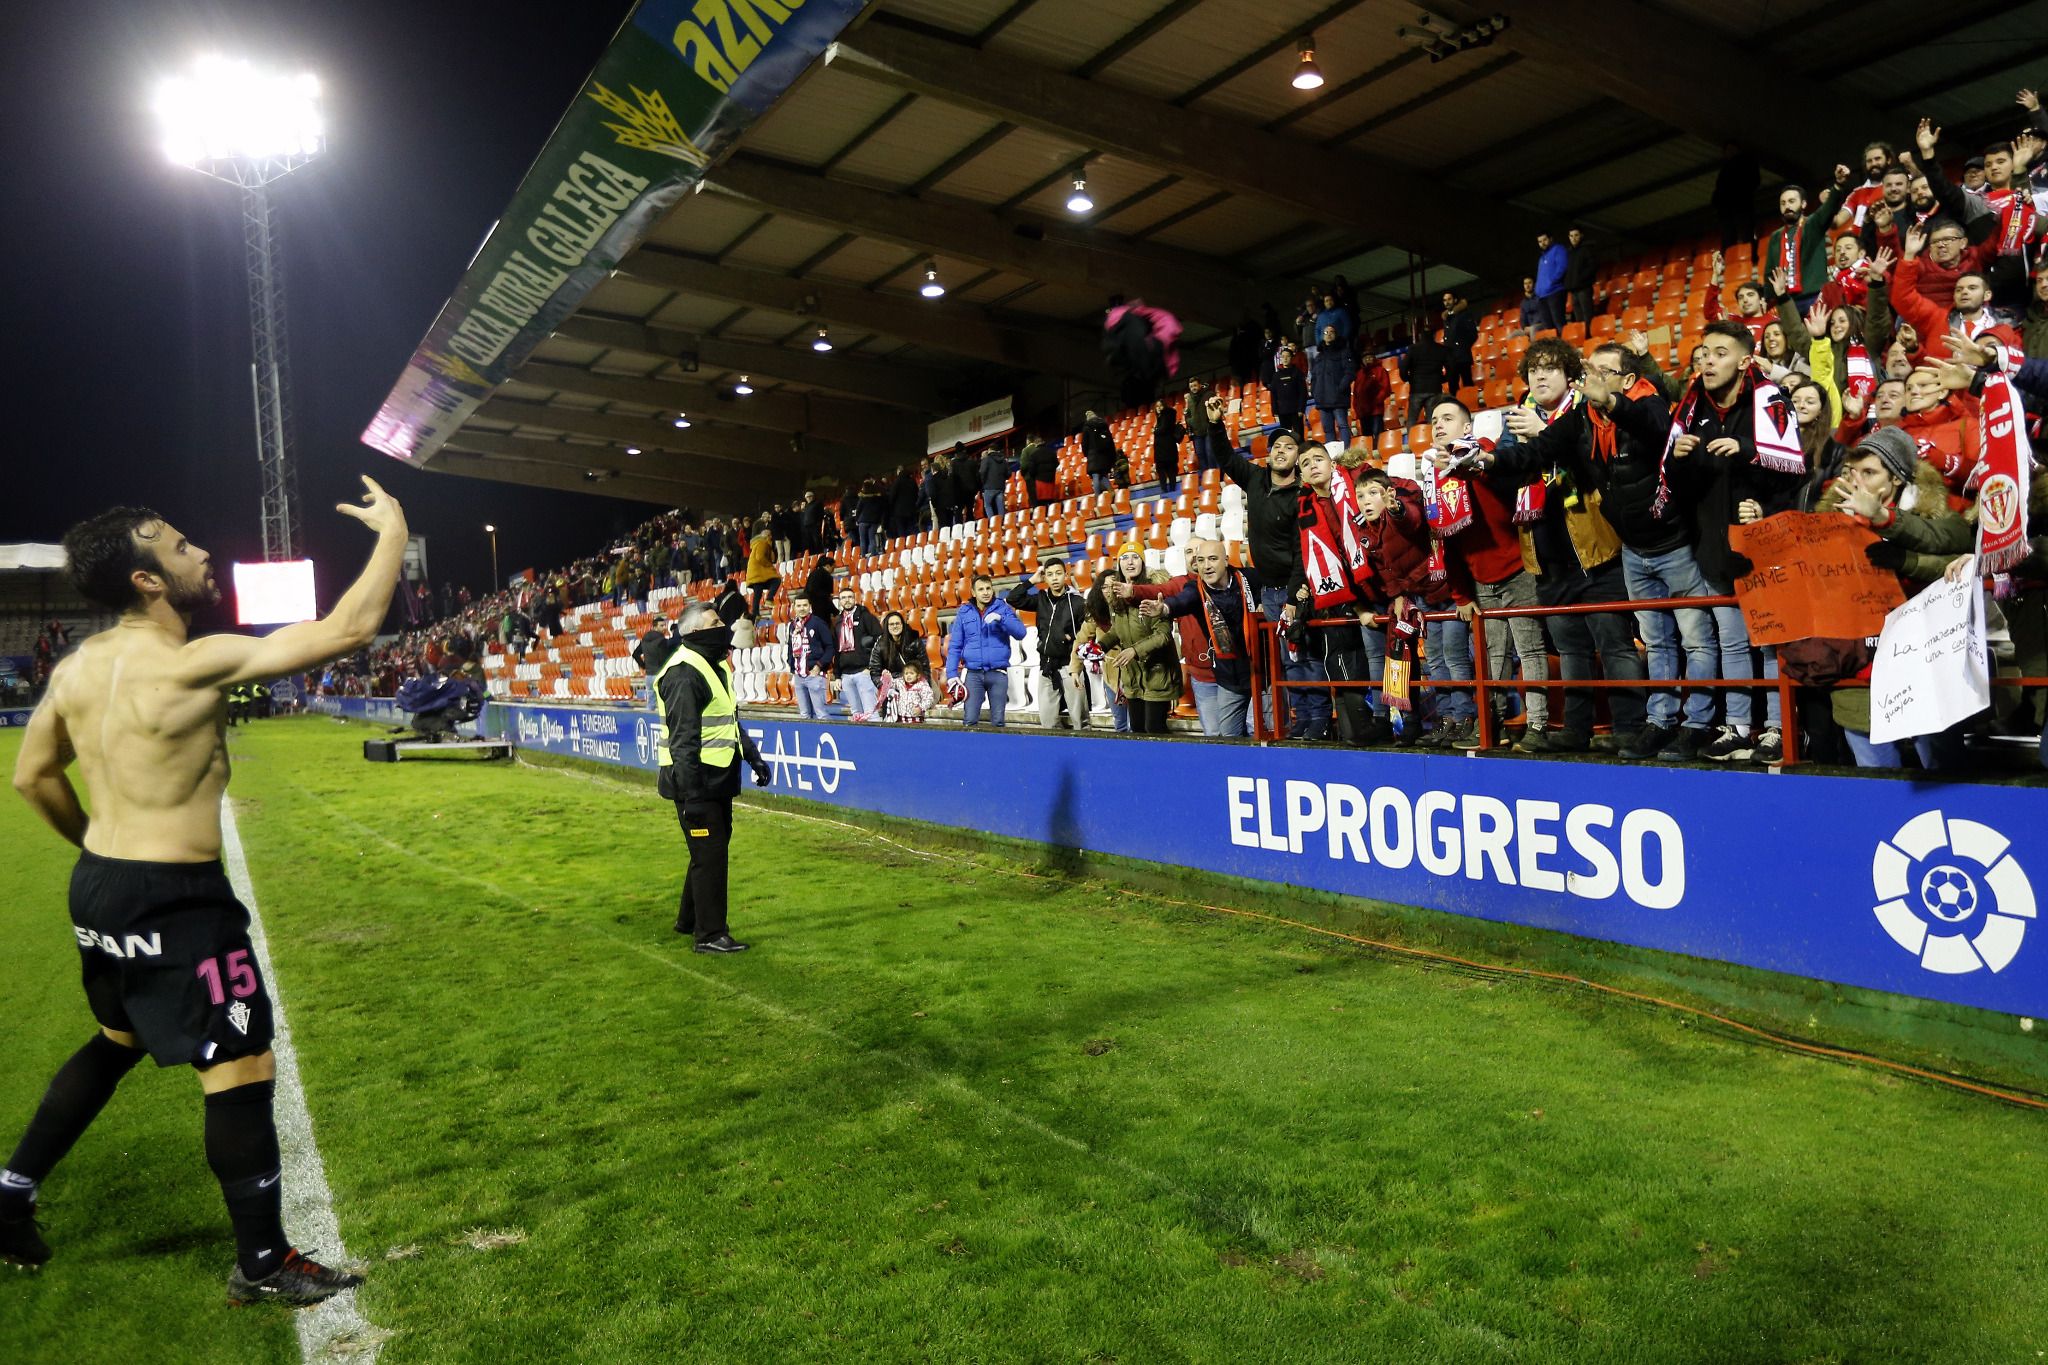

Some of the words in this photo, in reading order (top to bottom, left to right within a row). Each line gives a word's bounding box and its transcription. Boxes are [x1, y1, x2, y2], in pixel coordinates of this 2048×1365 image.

[526, 150, 651, 267] GALEGA
[479, 250, 570, 327] RURAL
[448, 308, 520, 366] CAIXA
[1743, 565, 1788, 593] DAME
[1893, 641, 1918, 658] La
[1878, 684, 1913, 709] Vamos
[582, 713, 618, 735] FUNERARIA
[582, 737, 621, 761] FERNANDEZ
[196, 949, 257, 1005] 15
